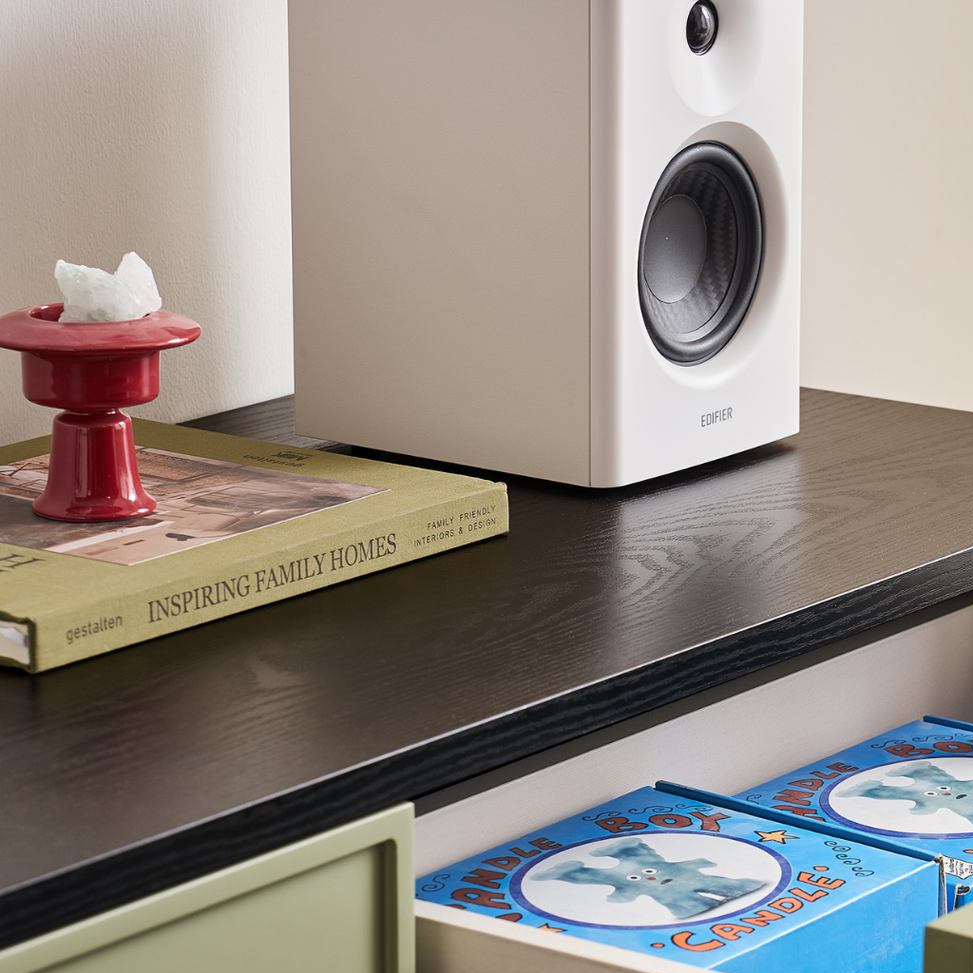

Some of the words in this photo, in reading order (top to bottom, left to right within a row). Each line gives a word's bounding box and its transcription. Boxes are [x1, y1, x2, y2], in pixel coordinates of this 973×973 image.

[701, 407, 733, 428] EDIFIER
[413, 529, 455, 547] INTERIORS
[458, 527, 464, 535] &
[467, 518, 496, 532] DESIGN
[427, 516, 454, 531] FAMILY
[459, 505, 496, 522] FRIENDLY
[147, 575, 251, 624] INSPIRING
[254, 552, 327, 593] FAMILY
[330, 533, 397, 572] HOMES
[66, 616, 123, 645] gestalten
[771, 762, 859, 822] ANDLE
[444, 837, 563, 923] ANDLE
[671, 871, 846, 952] CANDLE
